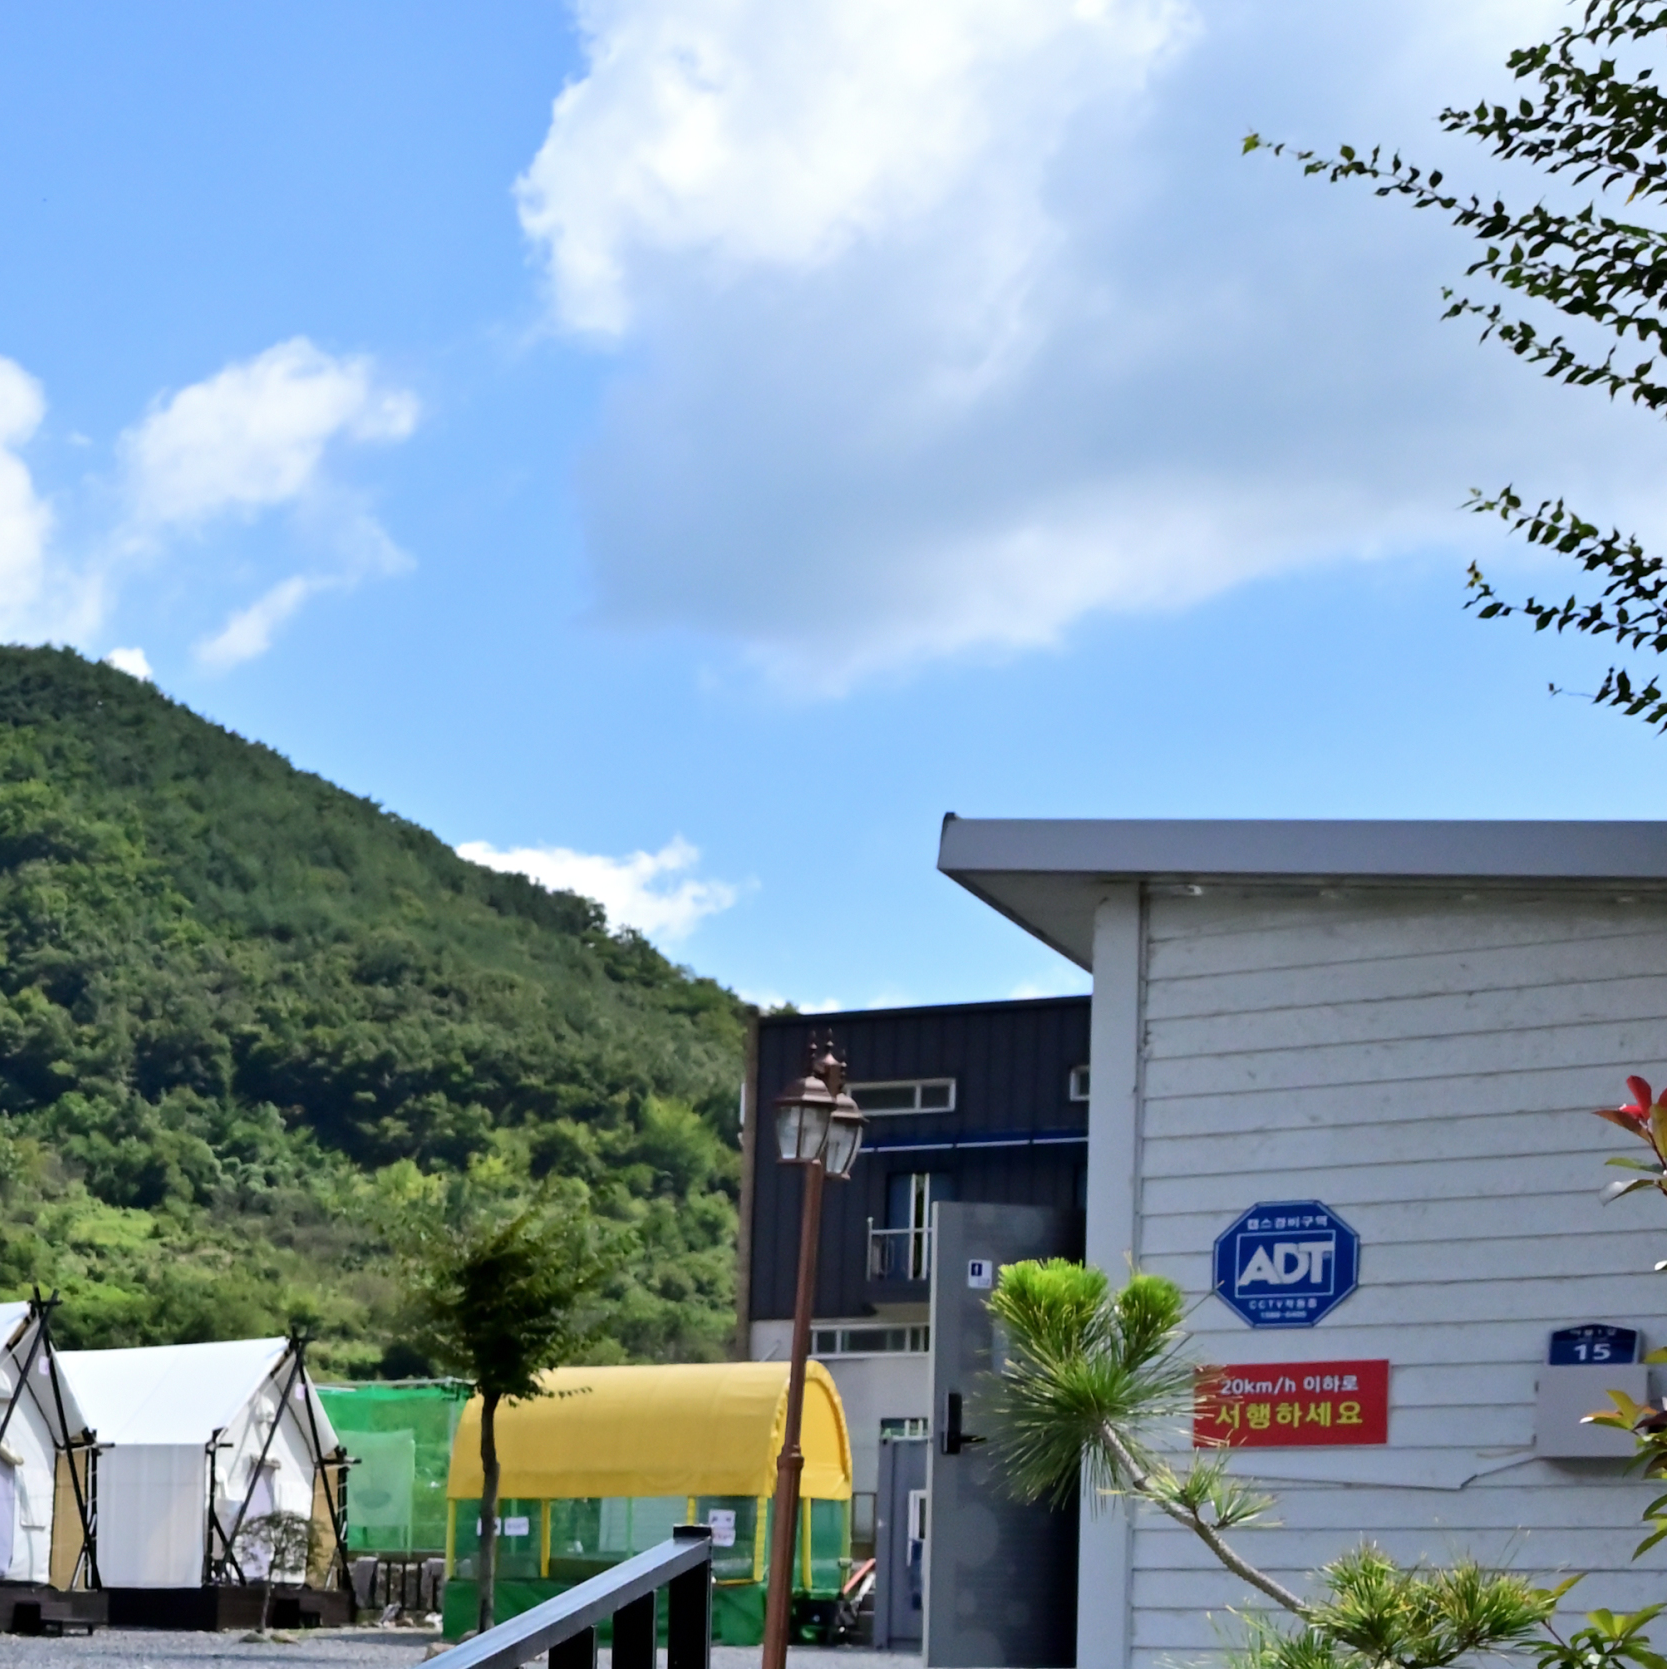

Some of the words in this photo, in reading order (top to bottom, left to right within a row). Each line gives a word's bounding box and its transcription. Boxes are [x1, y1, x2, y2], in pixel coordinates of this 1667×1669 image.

[1236, 1241, 1334, 1287] ADT
[1573, 1343, 1611, 1361] 15
[1220, 1377, 1296, 1395] 20km/h
[1303, 1375, 1359, 1393] 이하로
[1215, 1401, 1364, 1430] 서행하세요
